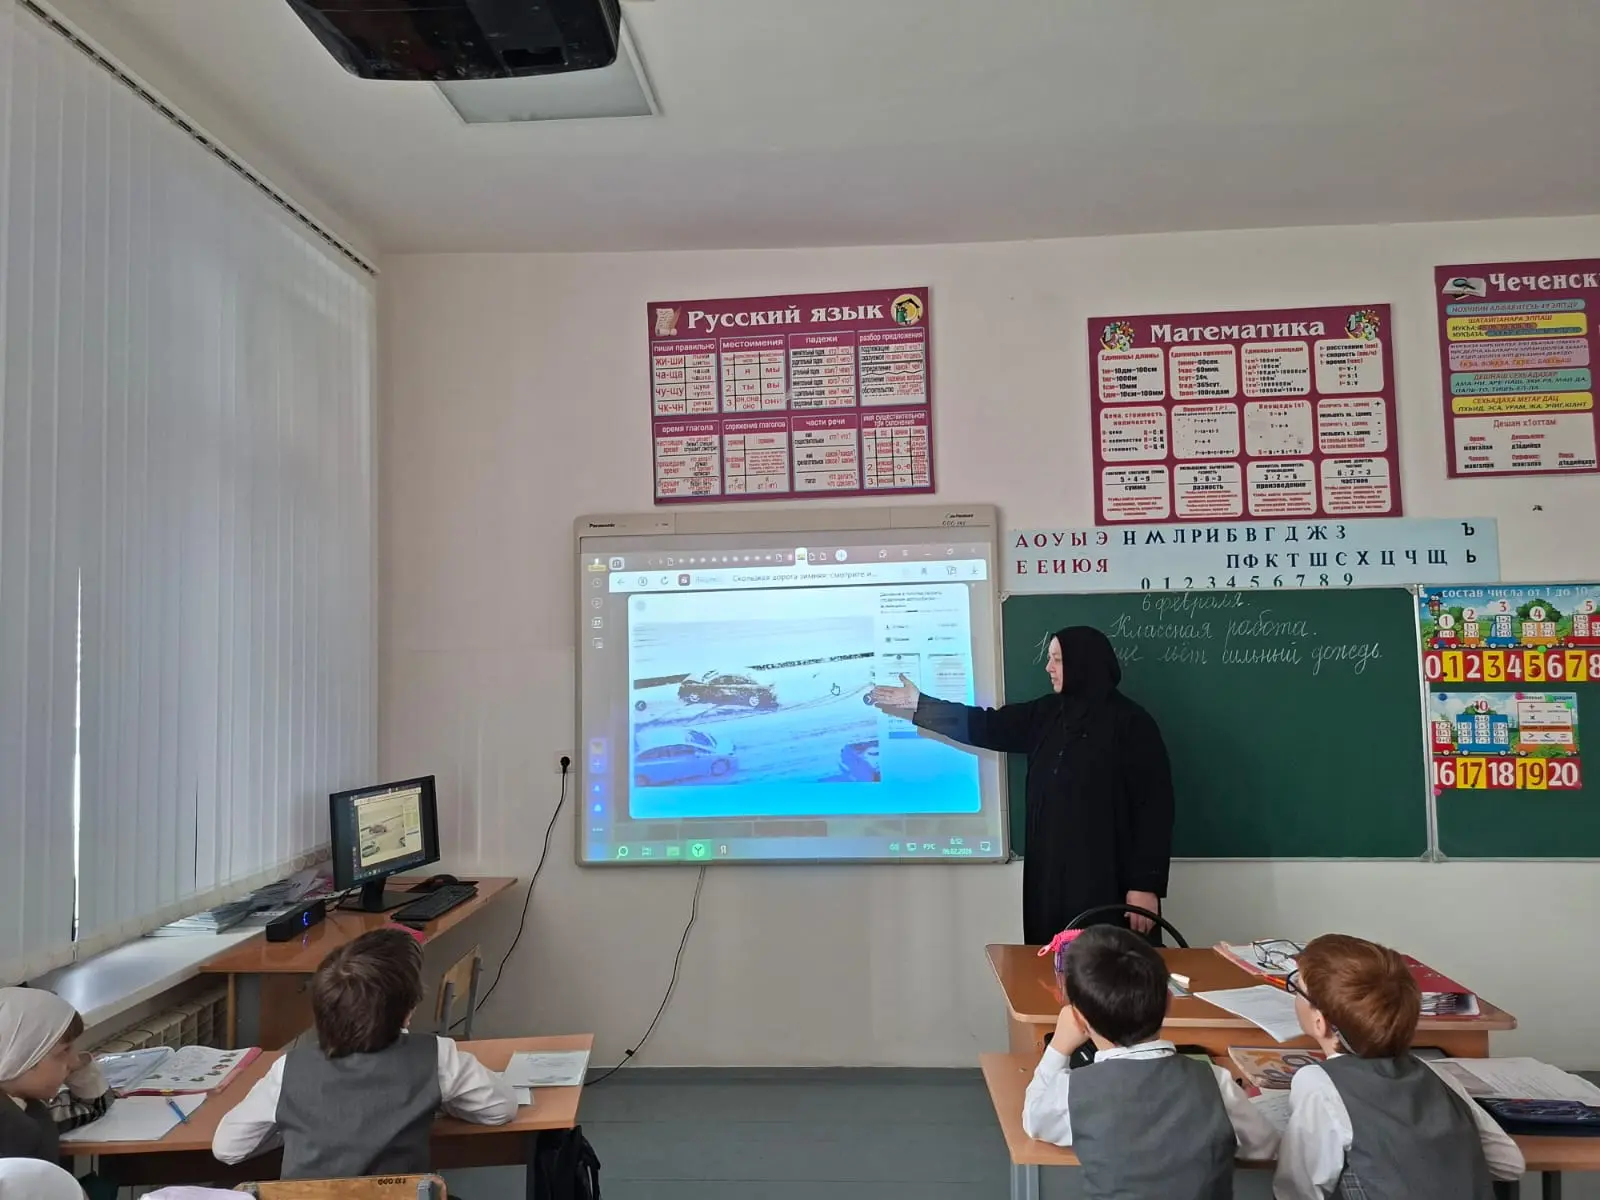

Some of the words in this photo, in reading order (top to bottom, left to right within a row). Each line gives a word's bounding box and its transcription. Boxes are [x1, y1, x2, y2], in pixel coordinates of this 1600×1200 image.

[1488, 273, 1600, 292] Чеченск
[688, 304, 800, 333] Русский
[810, 304, 884, 323] язык
[1150, 321, 1326, 343] Математика
[722, 339, 784, 349] местоимения
[805, 335, 839, 345] падежи
[654, 345, 674, 353] пиши
[675, 343, 715, 353] правильно
[655, 358, 684, 366] жи-ши
[655, 370, 684, 380] ча-ща
[655, 386, 684, 398] чу-щу
[658, 403, 684, 413] чк-чн
[828, 418, 846, 427] речи
[662, 426, 684, 434] время
[686, 424, 714, 432] глагола
[772, 573, 798, 582] дорога
[1141, 577, 1151, 590] 0
[1163, 576, 1170, 590] 1
[1184, 576, 1194, 590] 2
[1207, 576, 1217, 589] 3
[1226, 575, 1237, 589] 4
[1249, 575, 1260, 589] 5
[1273, 574, 1283, 588] 6
[1295, 574, 1306, 588] 7
[1319, 573, 1329, 588] 8
[1342, 573, 1354, 588] 9
[1442, 587, 1484, 598] состав
[1487, 588, 1524, 598] числа
[1527, 588, 1541, 598] от
[1545, 587, 1550, 597] 1
[1555, 587, 1571, 598] до
[1575, 586, 1589, 597] 10
[1142, 594, 1151, 611] 6
[1499, 601, 1507, 613] 3
[1586, 600, 1593, 612] 5
[1467, 609, 1475, 620] 2
[1533, 608, 1542, 619] 4
[1107, 612, 1214, 640] Классная
[1443, 615, 1449, 627] 1
[1222, 641, 1303, 665] сильный
[1425, 654, 1441, 679] 0
[1449, 655, 1458, 678] 1
[1466, 654, 1481, 679] 2
[1487, 654, 1501, 679] 3
[1507, 654, 1522, 679] 4
[1527, 655, 1542, 679] 5
[1547, 654, 1563, 679] 6
[1569, 654, 1583, 678] 7
[1589, 654, 1600, 678] 8
[1433, 761, 1456, 786] 16
[1460, 762, 1483, 786] 17
[1488, 761, 1514, 786] 18
[1518, 762, 1544, 786] 19
[1548, 761, 1579, 786] 20
